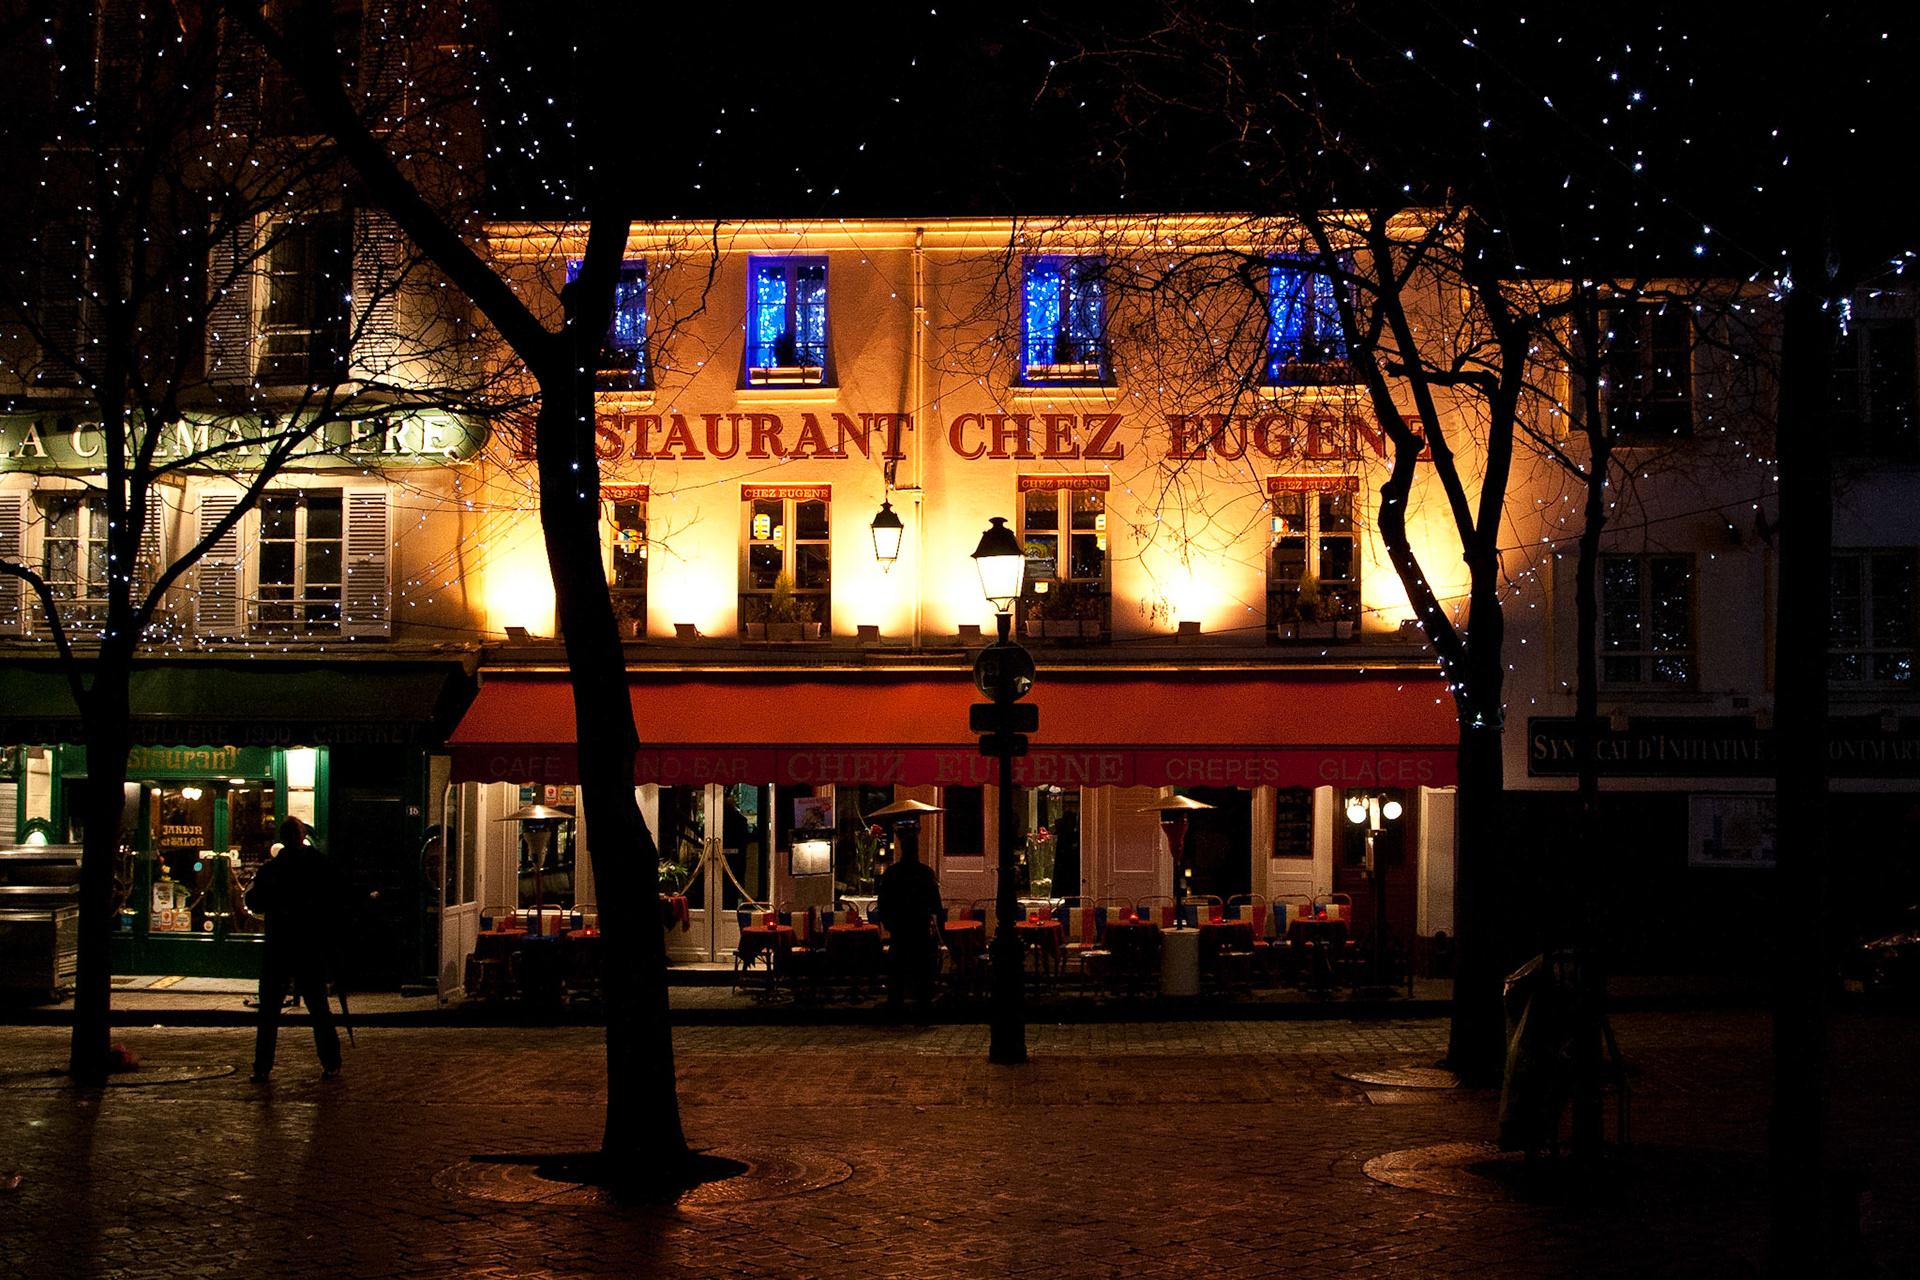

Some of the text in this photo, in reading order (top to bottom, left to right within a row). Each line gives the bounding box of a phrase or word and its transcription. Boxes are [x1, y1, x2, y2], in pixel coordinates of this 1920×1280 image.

[516, 413, 912, 460] STAURANT
[949, 413, 1124, 461] CHEZ
[744, 488, 828, 498] CHEZ EUGENE
[1021, 479, 1107, 489] CHEZ EUGENE
[1270, 481, 1302, 490] CHEZ
[244, 724, 292, 744] 1900
[1533, 734, 1632, 761] SYNCAT
[489, 756, 561, 778] CAFE
[787, 753, 1124, 782] CHEZ EUGENE
[1165, 758, 1280, 780] CREPES
[1318, 758, 1434, 780] GLACES
